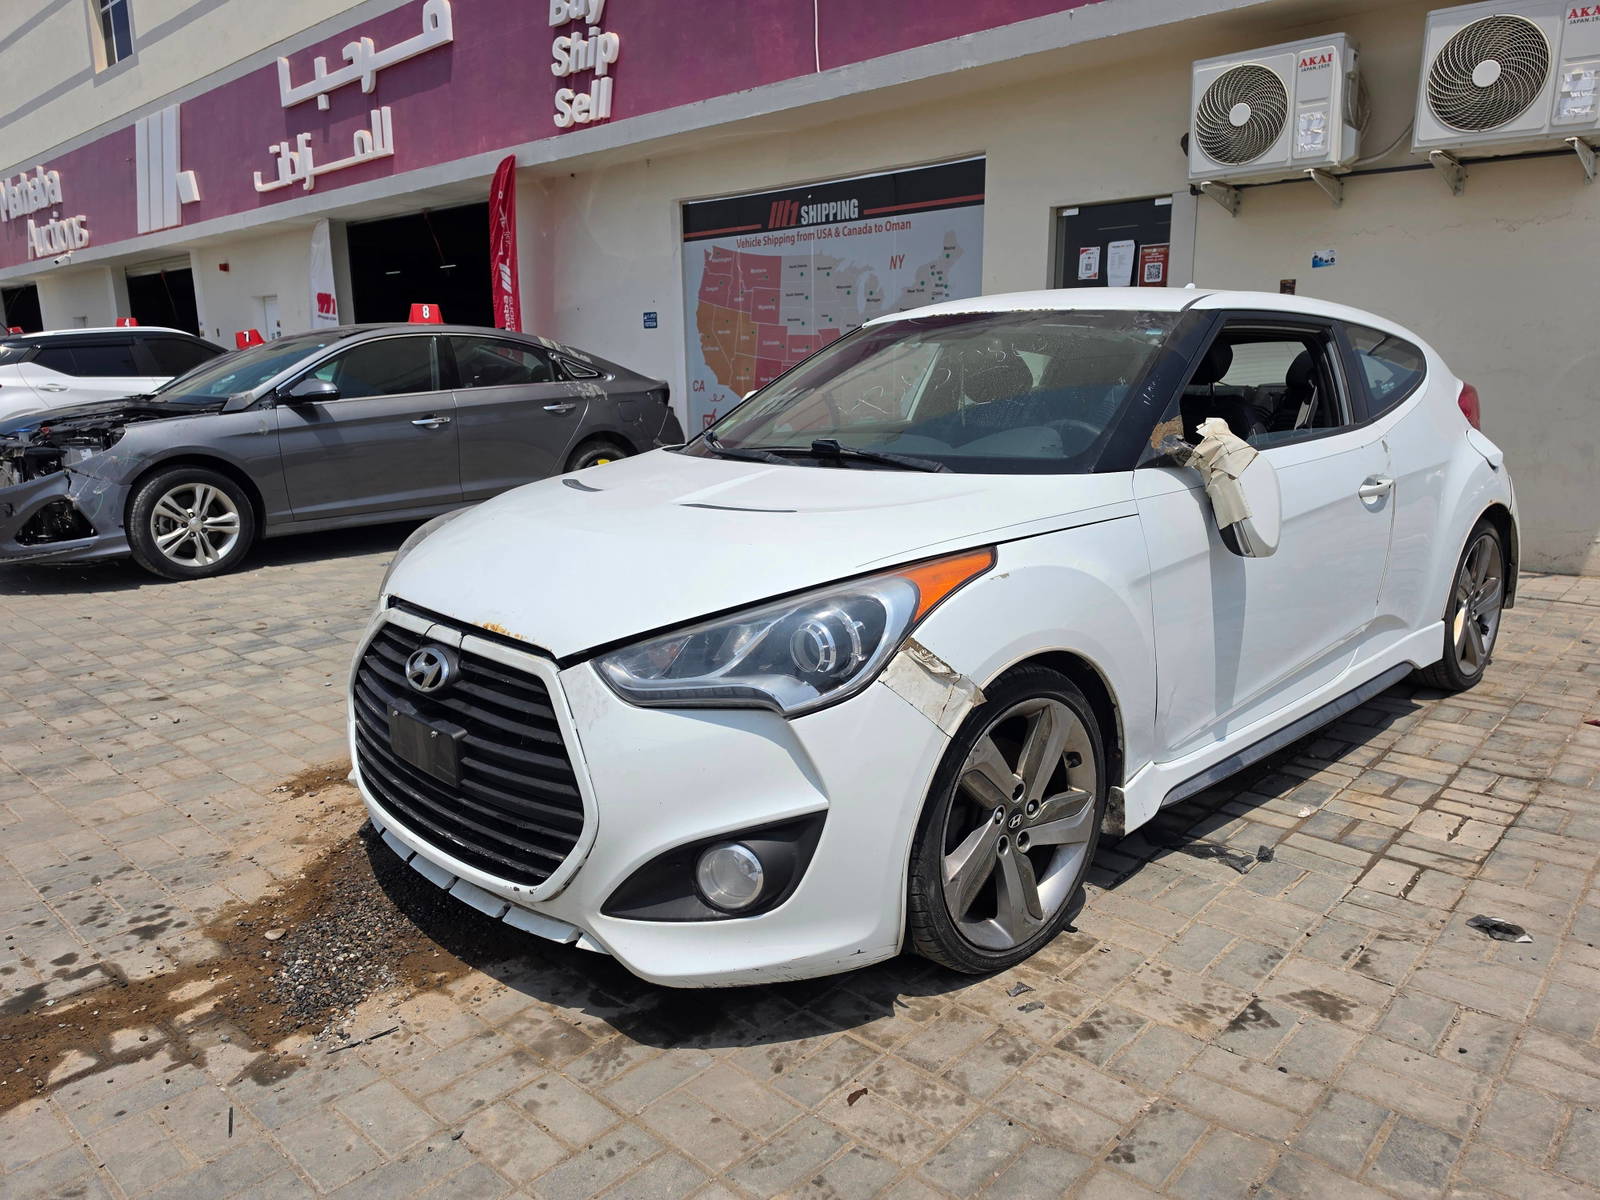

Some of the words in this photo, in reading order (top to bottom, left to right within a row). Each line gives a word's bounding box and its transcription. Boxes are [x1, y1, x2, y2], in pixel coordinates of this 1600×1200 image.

[1568, 5, 1600, 19] AKA
[551, 26, 619, 77] Ship
[1299, 53, 1334, 68] AKAI
[553, 76, 613, 127] Sell
[800, 199, 859, 225] SHIPPING
[736, 236, 762, 249] Vehicle
[763, 232, 796, 248] Shipping
[797, 231, 815, 242] from
[816, 227, 833, 240] USA
[834, 226, 841, 238] &
[842, 223, 873, 237] Canada
[874, 222, 884, 233] to
[885, 220, 912, 232] Oman
[889, 253, 905, 270] NY
[422, 305, 430, 319] 8
[243, 331, 250, 342] 7
[692, 380, 705, 392] CA
